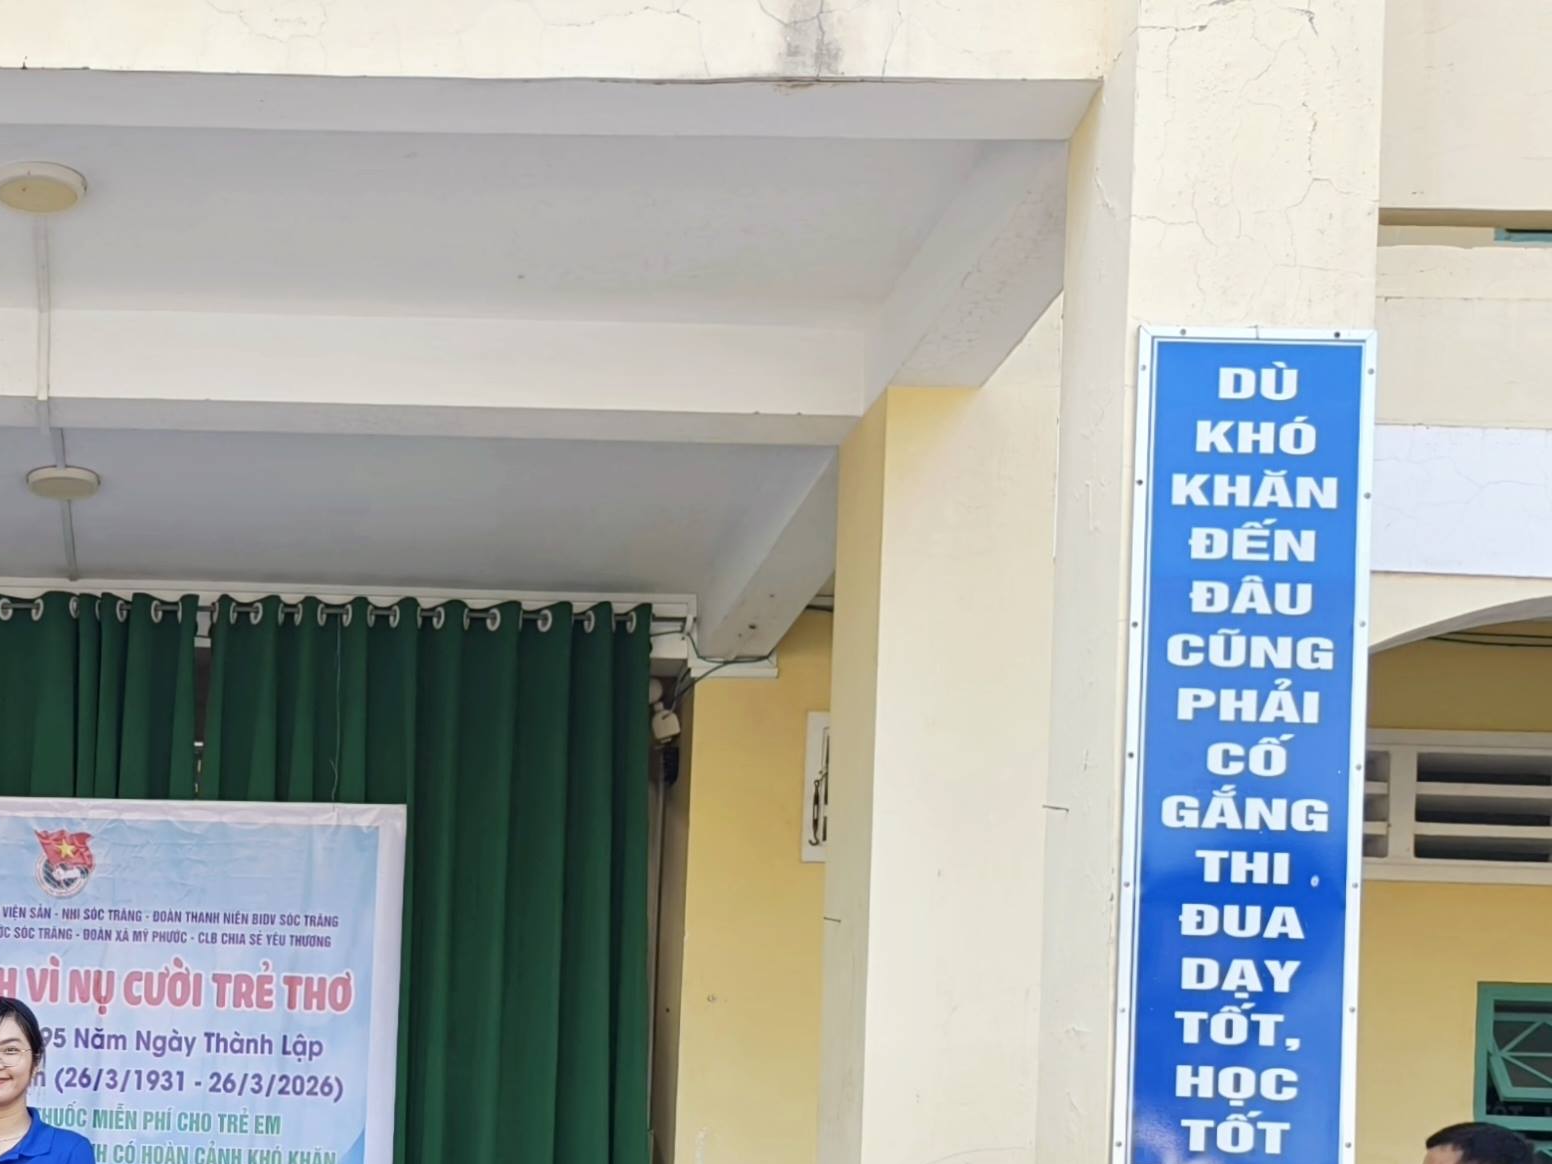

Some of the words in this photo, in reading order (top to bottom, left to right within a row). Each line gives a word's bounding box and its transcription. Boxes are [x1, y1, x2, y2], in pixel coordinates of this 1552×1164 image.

[1218, 361, 1298, 401] DÙ
[1195, 416, 1317, 455] KHÓ
[1171, 469, 1338, 509] KHĂN
[1188, 518, 1316, 562] ĐẾN
[1189, 575, 1313, 616] ĐÂU
[1167, 628, 1334, 670] CŨNG
[1177, 678, 1320, 724] PHẢI
[1207, 733, 1294, 777] CỐ
[1161, 784, 1329, 832] GẮNG
[1195, 849, 1290, 885] THI
[14, 925, 35, 939] SÓC
[83, 927, 112, 941] ĐOÀN
[198, 933, 217, 944] CLB
[221, 933, 245, 944] CHIA
[266, 932, 286, 946] YÊU
[290, 934, 331, 947] THƯƠNG
[62, 909, 80, 920] NHI
[83, 907, 104, 920] SÓC
[153, 909, 182, 922] ĐOÀN
[186, 912, 220, 923] THANH
[224, 911, 248, 924] NIÊN
[252, 914, 276, 925] BIDV
[280, 913, 300, 926] SÓC
[1179, 903, 1305, 939] ĐUA
[26, 955, 60, 1003] VÌ
[69, 969, 115, 1015] NỤ
[123, 957, 203, 1007] CƯỜI
[212, 961, 274, 1009] TRẺ
[283, 971, 353, 1011] THƠ
[1181, 957, 1301, 999] DẠY
[74, 1027, 127, 1050] Năm
[136, 1029, 196, 1057] Ngày
[204, 1031, 273, 1056] Thành
[282, 1033, 323, 1062] Lập
[1174, 1002, 1301, 1051] TỐT,
[54, 1067, 185, 1094] (26/3/1931
[208, 1071, 344, 1103] 26/3/2026)
[1175, 1065, 1298, 1107] HỌC
[38, 1100, 88, 1128] HUỐC
[92, 1103, 137, 1130] MIỄN
[143, 1106, 171, 1131] PHÍ
[177, 1113, 212, 1133] CHO
[218, 1107, 248, 1134] TRẺ
[254, 1115, 282, 1135] EM
[1180, 1111, 1291, 1155] TỐT
[113, 1140, 136, 1164] CÓ
